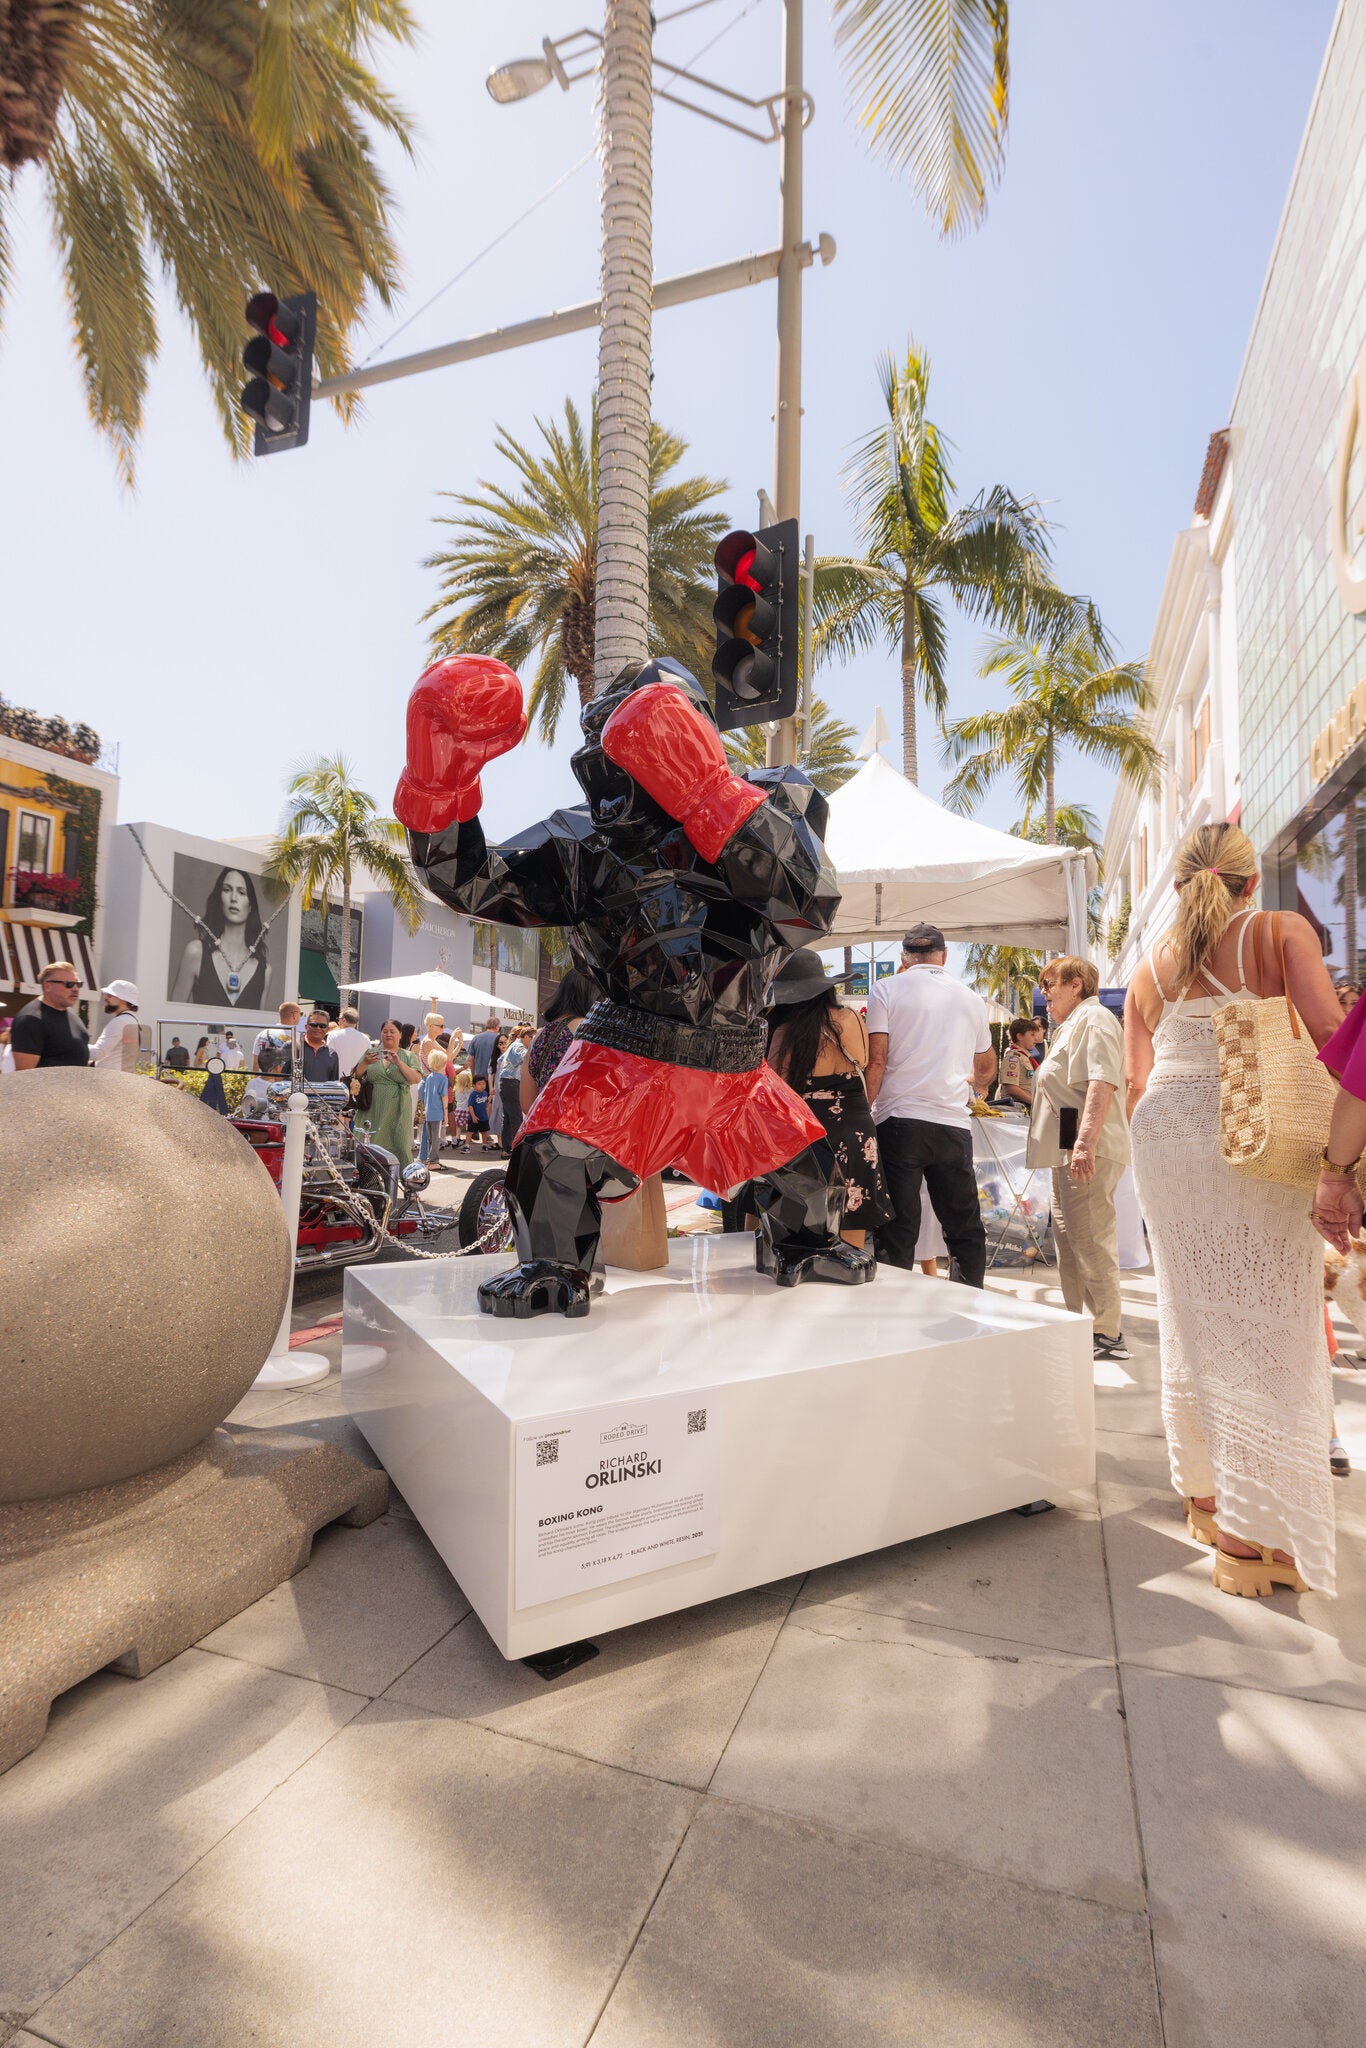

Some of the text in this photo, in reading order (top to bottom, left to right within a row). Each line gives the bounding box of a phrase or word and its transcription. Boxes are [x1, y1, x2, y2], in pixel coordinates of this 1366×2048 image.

[503, 1008, 535, 1022] MaxMara
[603, 1431, 625, 1441] RODEO
[600, 1451, 648, 1471] RICHARD
[585, 1459, 662, 1489] ORLINSKI
[538, 1505, 604, 1528] BOXING KONG
[630, 1545, 647, 1556] BLACK
[647, 1542, 659, 1551] AND
